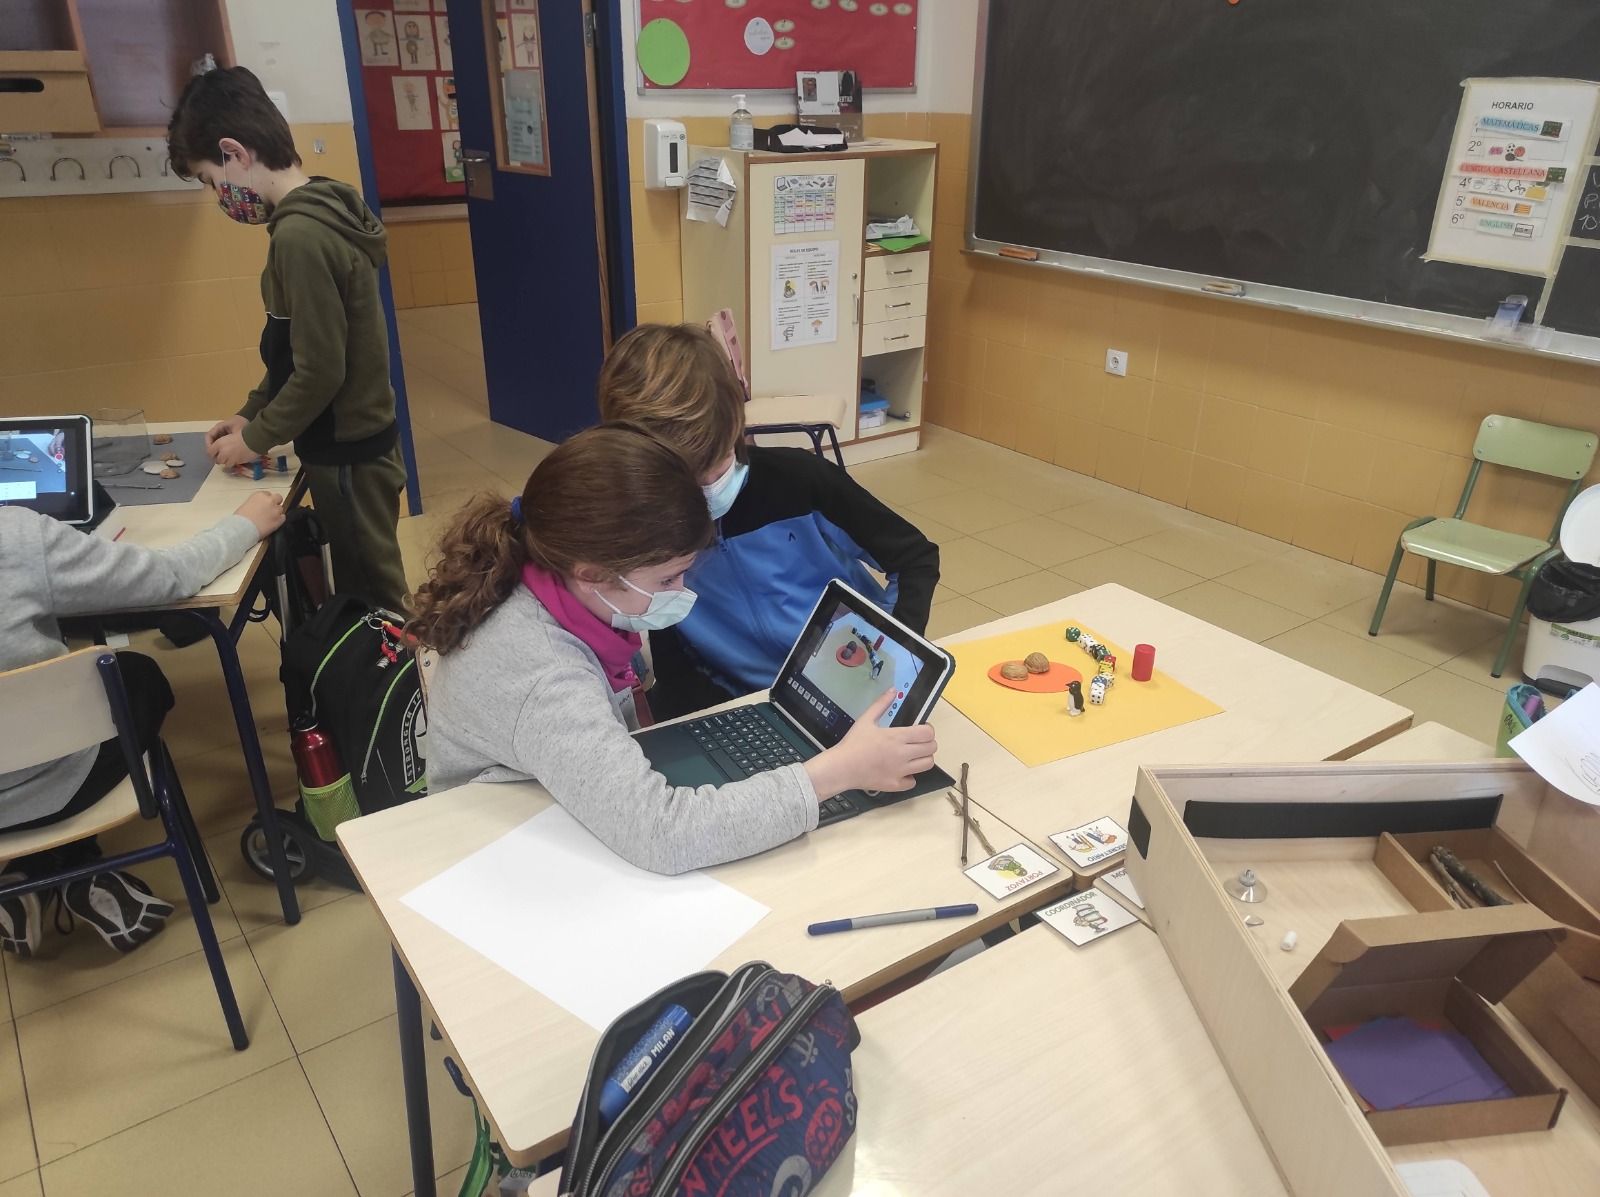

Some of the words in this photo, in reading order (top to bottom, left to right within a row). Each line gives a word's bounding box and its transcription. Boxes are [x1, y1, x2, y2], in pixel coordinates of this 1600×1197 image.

[1492, 101, 1534, 110] HORARIO
[1493, 166, 1545, 177] CASTELLANA
[403, 711, 413, 777] STRONGER
[1005, 870, 1043, 891] PORTAVOZ
[1045, 892, 1097, 916] COORDINADOR
[651, 1028, 675, 1058] MILAN
